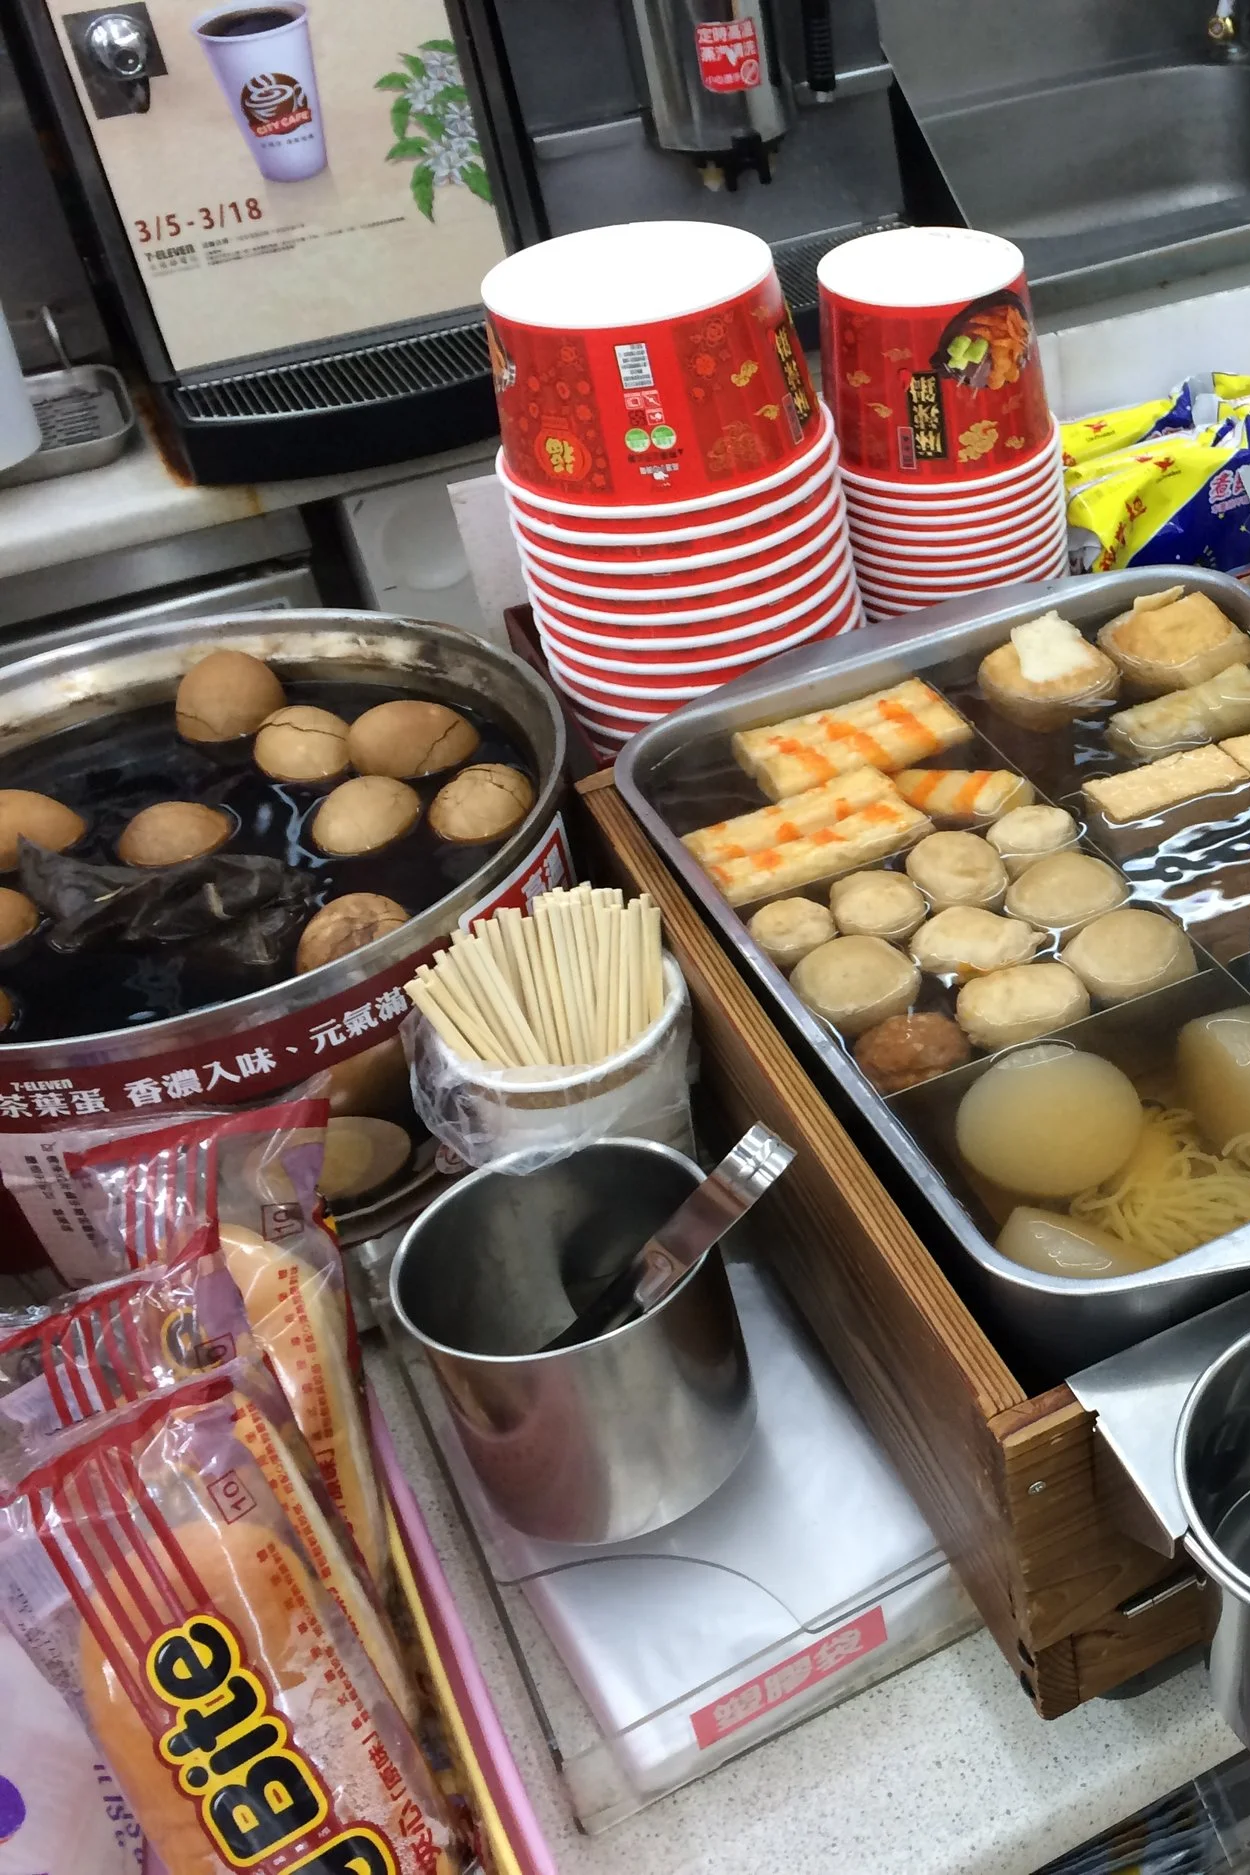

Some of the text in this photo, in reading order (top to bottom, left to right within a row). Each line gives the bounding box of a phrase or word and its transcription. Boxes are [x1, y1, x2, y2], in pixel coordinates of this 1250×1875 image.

[909, 376, 943, 455] 麻辣鍋
[0, 1089, 109, 1118] 茶葉蛋
[222, 1479, 245, 1512] 10
[712, 1628, 864, 1733] 塑膠袋
[154, 1621, 320, 1861] Bite
